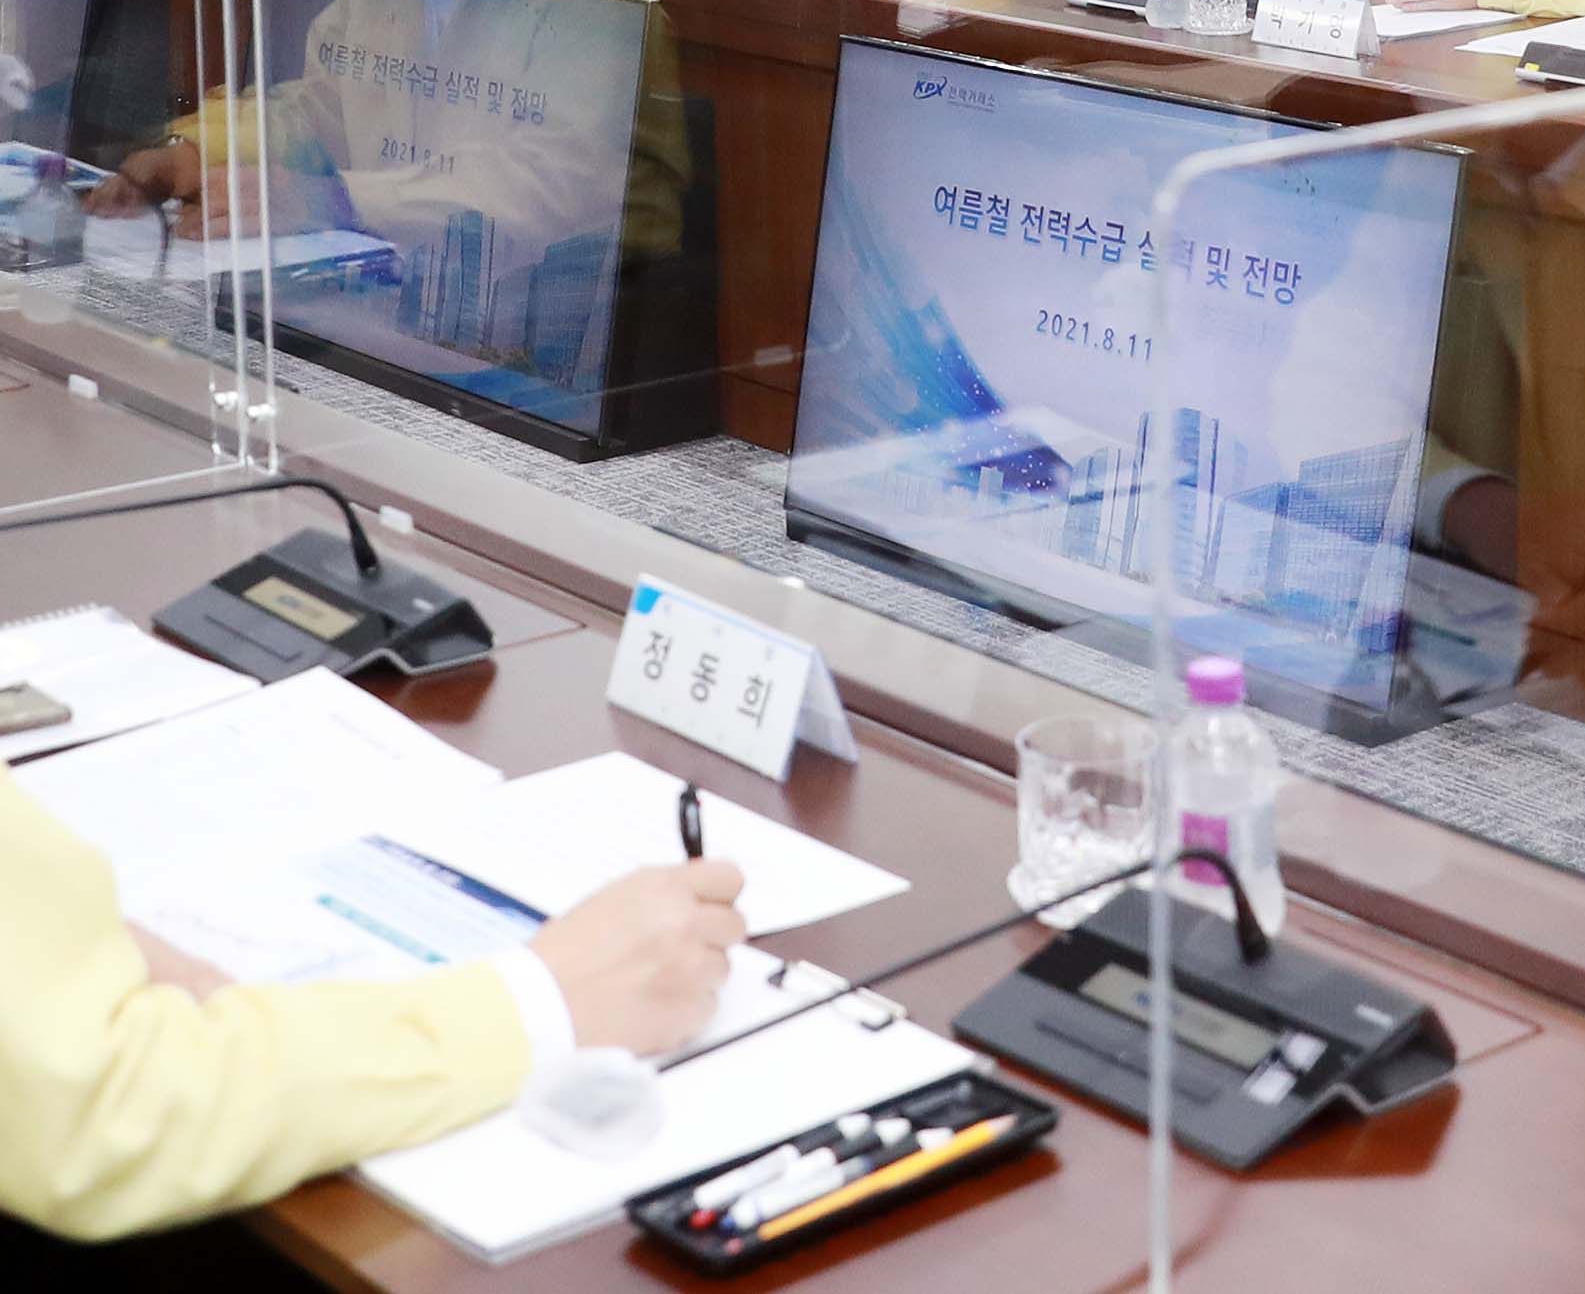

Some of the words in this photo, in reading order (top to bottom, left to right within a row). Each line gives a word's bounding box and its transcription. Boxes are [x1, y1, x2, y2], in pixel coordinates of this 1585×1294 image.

[372, 53, 439, 99] 전력수급
[934, 185, 1011, 237] 여름철
[1019, 202, 1127, 264] 전력수급
[1205, 242, 1231, 291] 및
[1242, 254, 1302, 306] 전망
[1036, 310, 1154, 361] 2021.8.11
